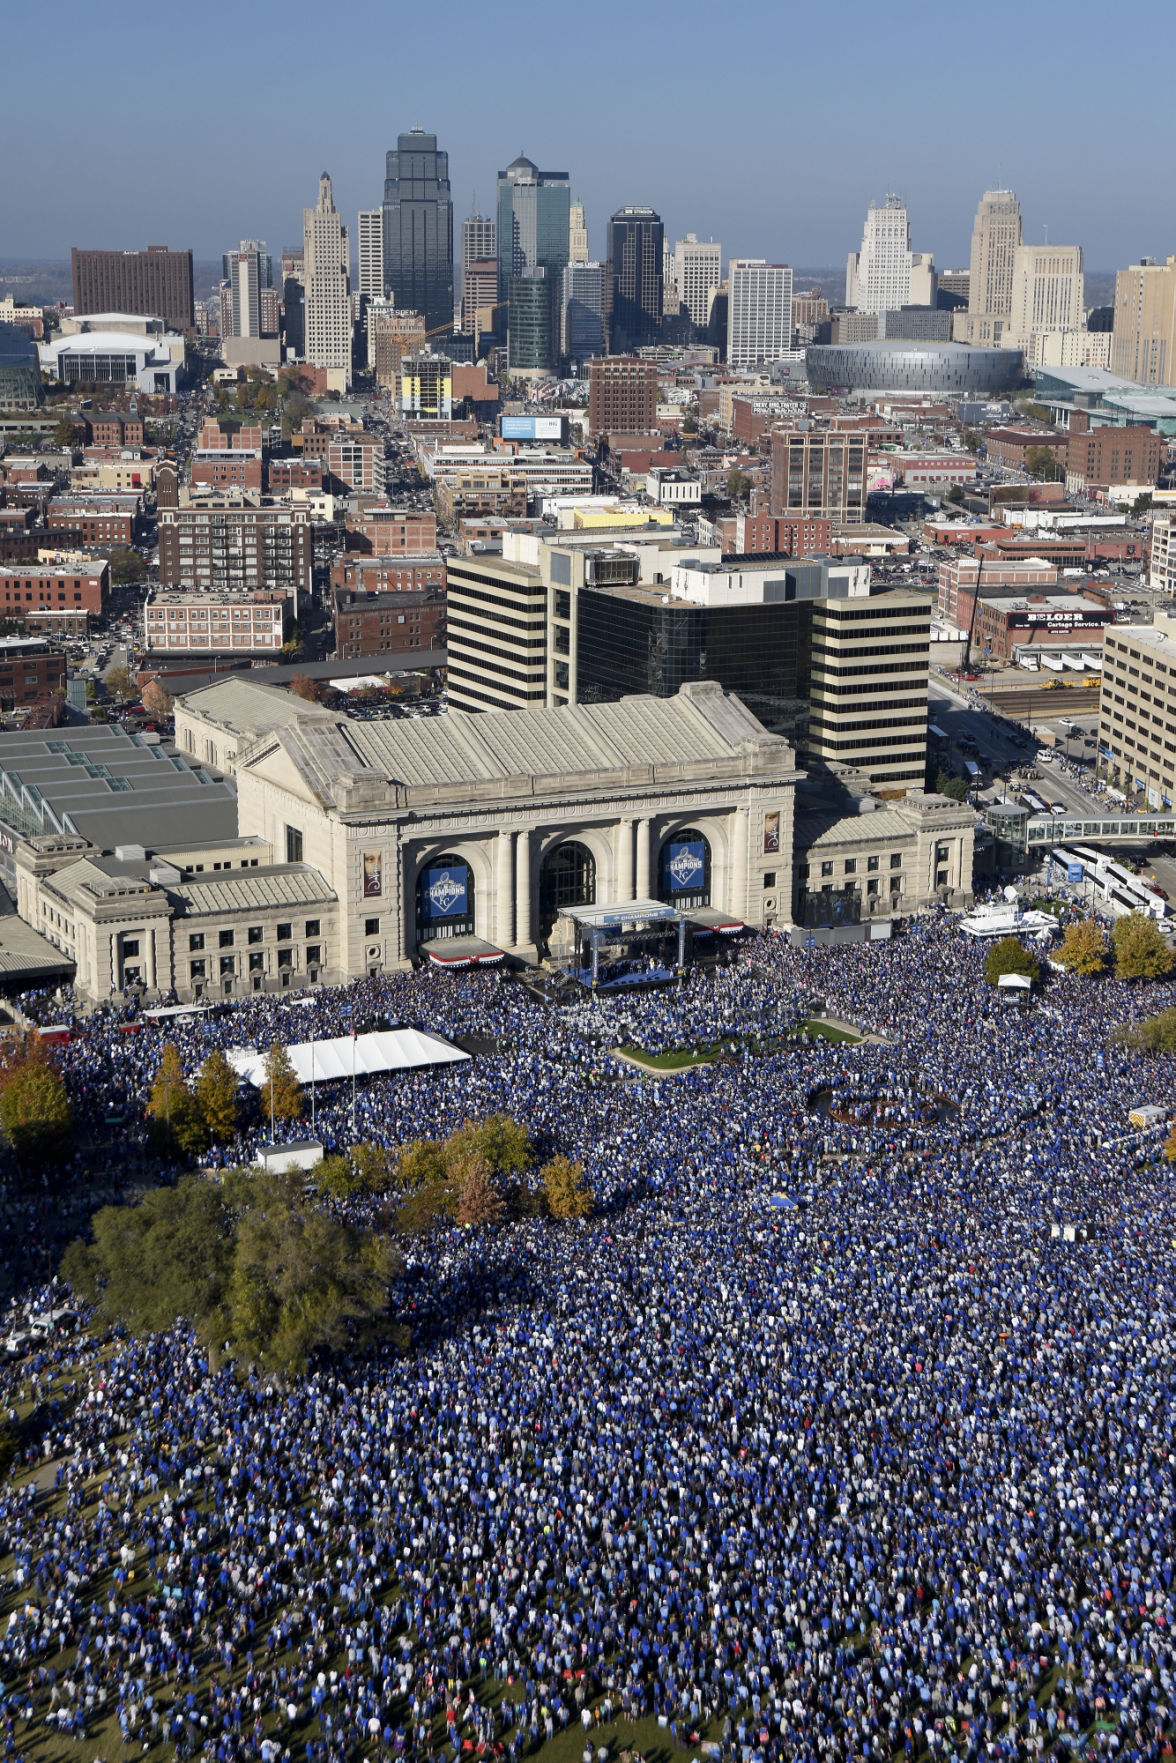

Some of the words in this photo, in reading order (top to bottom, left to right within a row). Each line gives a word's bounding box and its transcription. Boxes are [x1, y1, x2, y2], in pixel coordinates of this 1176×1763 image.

[1027, 613, 1084, 621] BELGER
[666, 860, 702, 872] CHAMPIONS
[425, 885, 465, 899] CHAMPIONS
